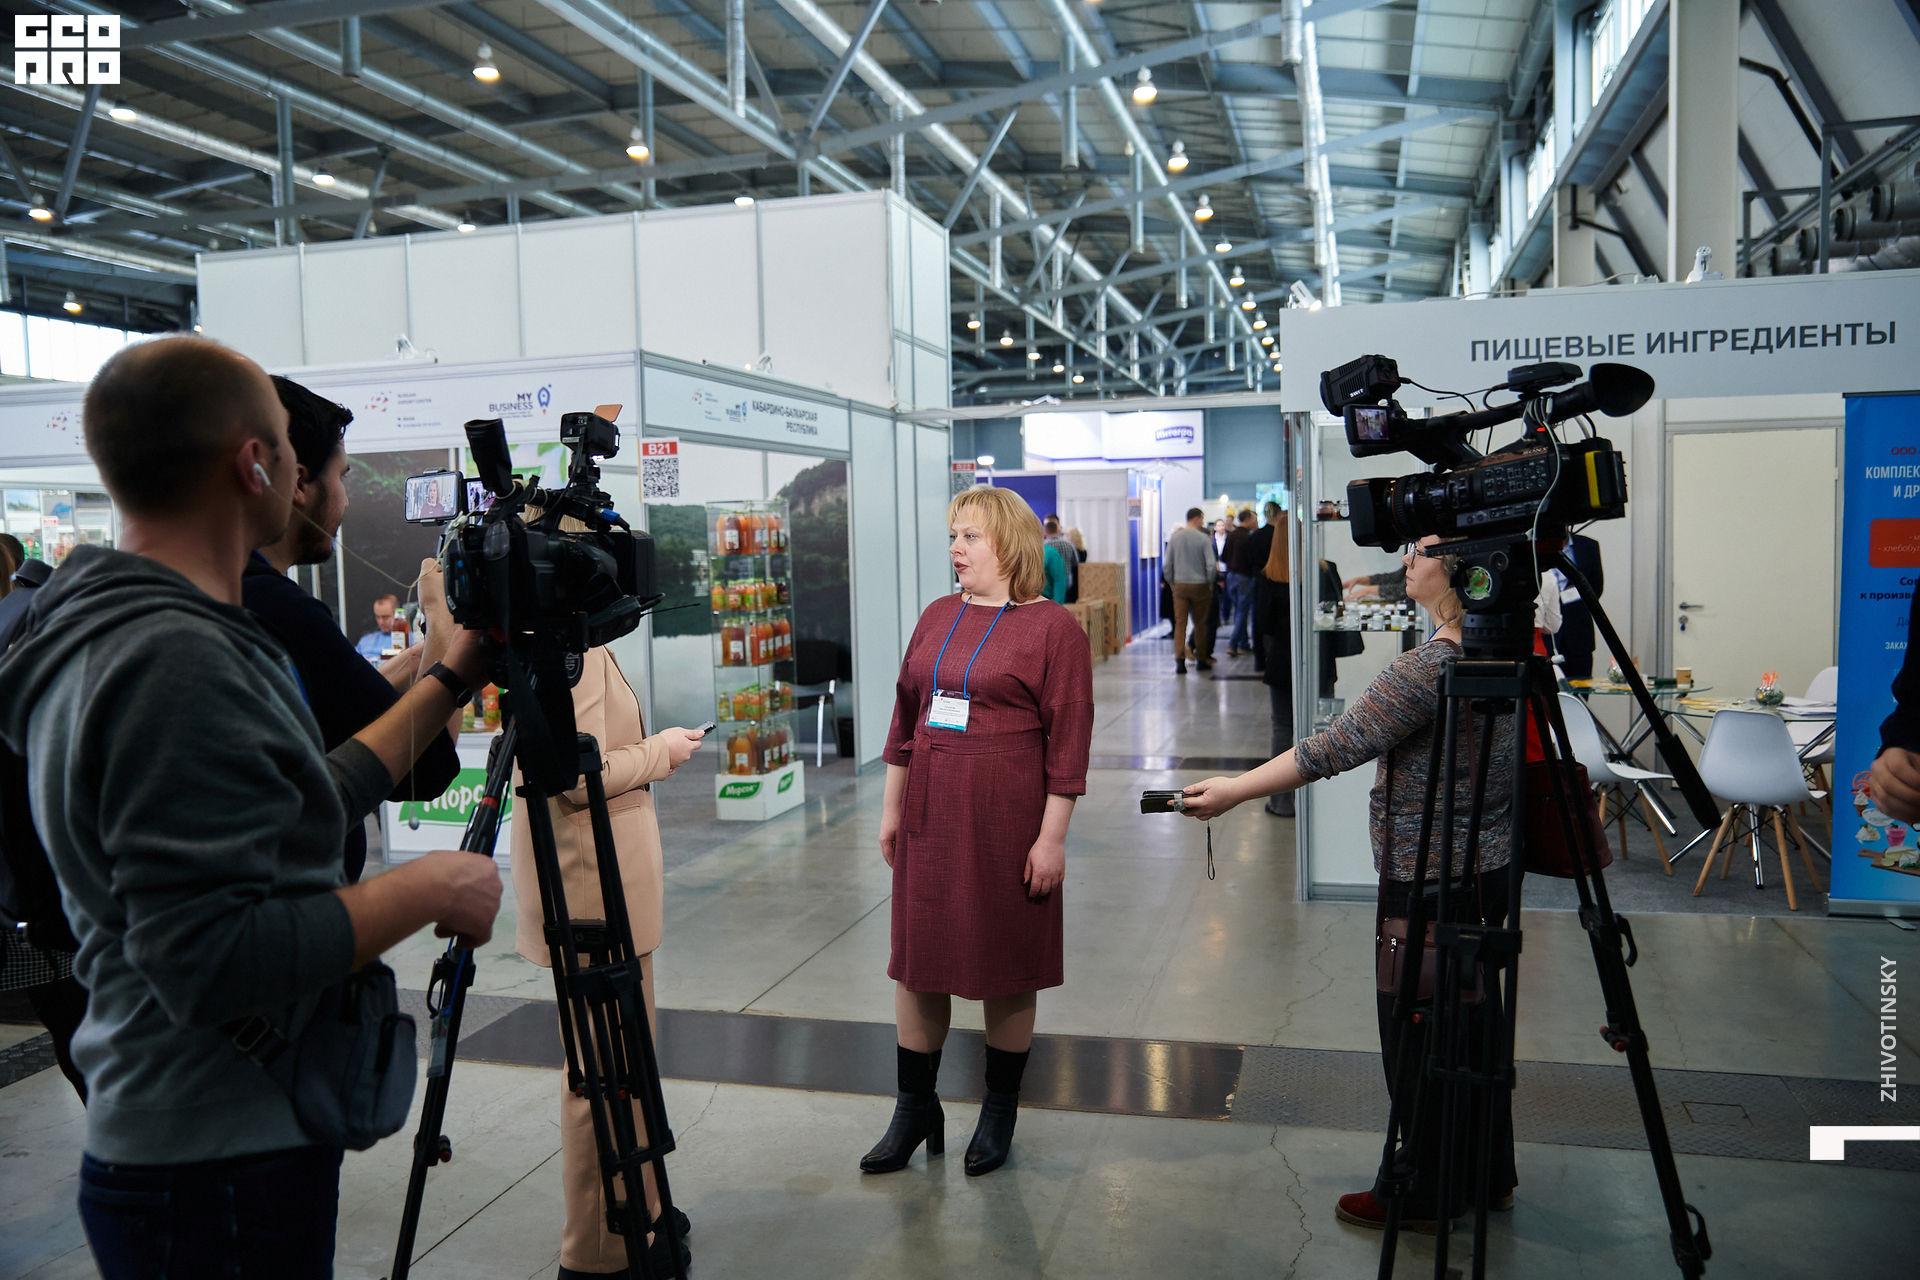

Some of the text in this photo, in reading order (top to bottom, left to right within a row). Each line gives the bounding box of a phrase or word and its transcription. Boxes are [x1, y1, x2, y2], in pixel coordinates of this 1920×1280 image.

[1470, 320, 1896, 363] ПИЩЕВЫЕ ИНГРЕДИЕНТЫ
[517, 392, 533, 401] MY
[488, 402, 534, 412] BUSINESS
[648, 442, 671, 455] B21
[1891, 446, 1917, 456] ООО
[1865, 465, 1920, 479] КОМПЛЕК
[1893, 485, 1901, 498] И
